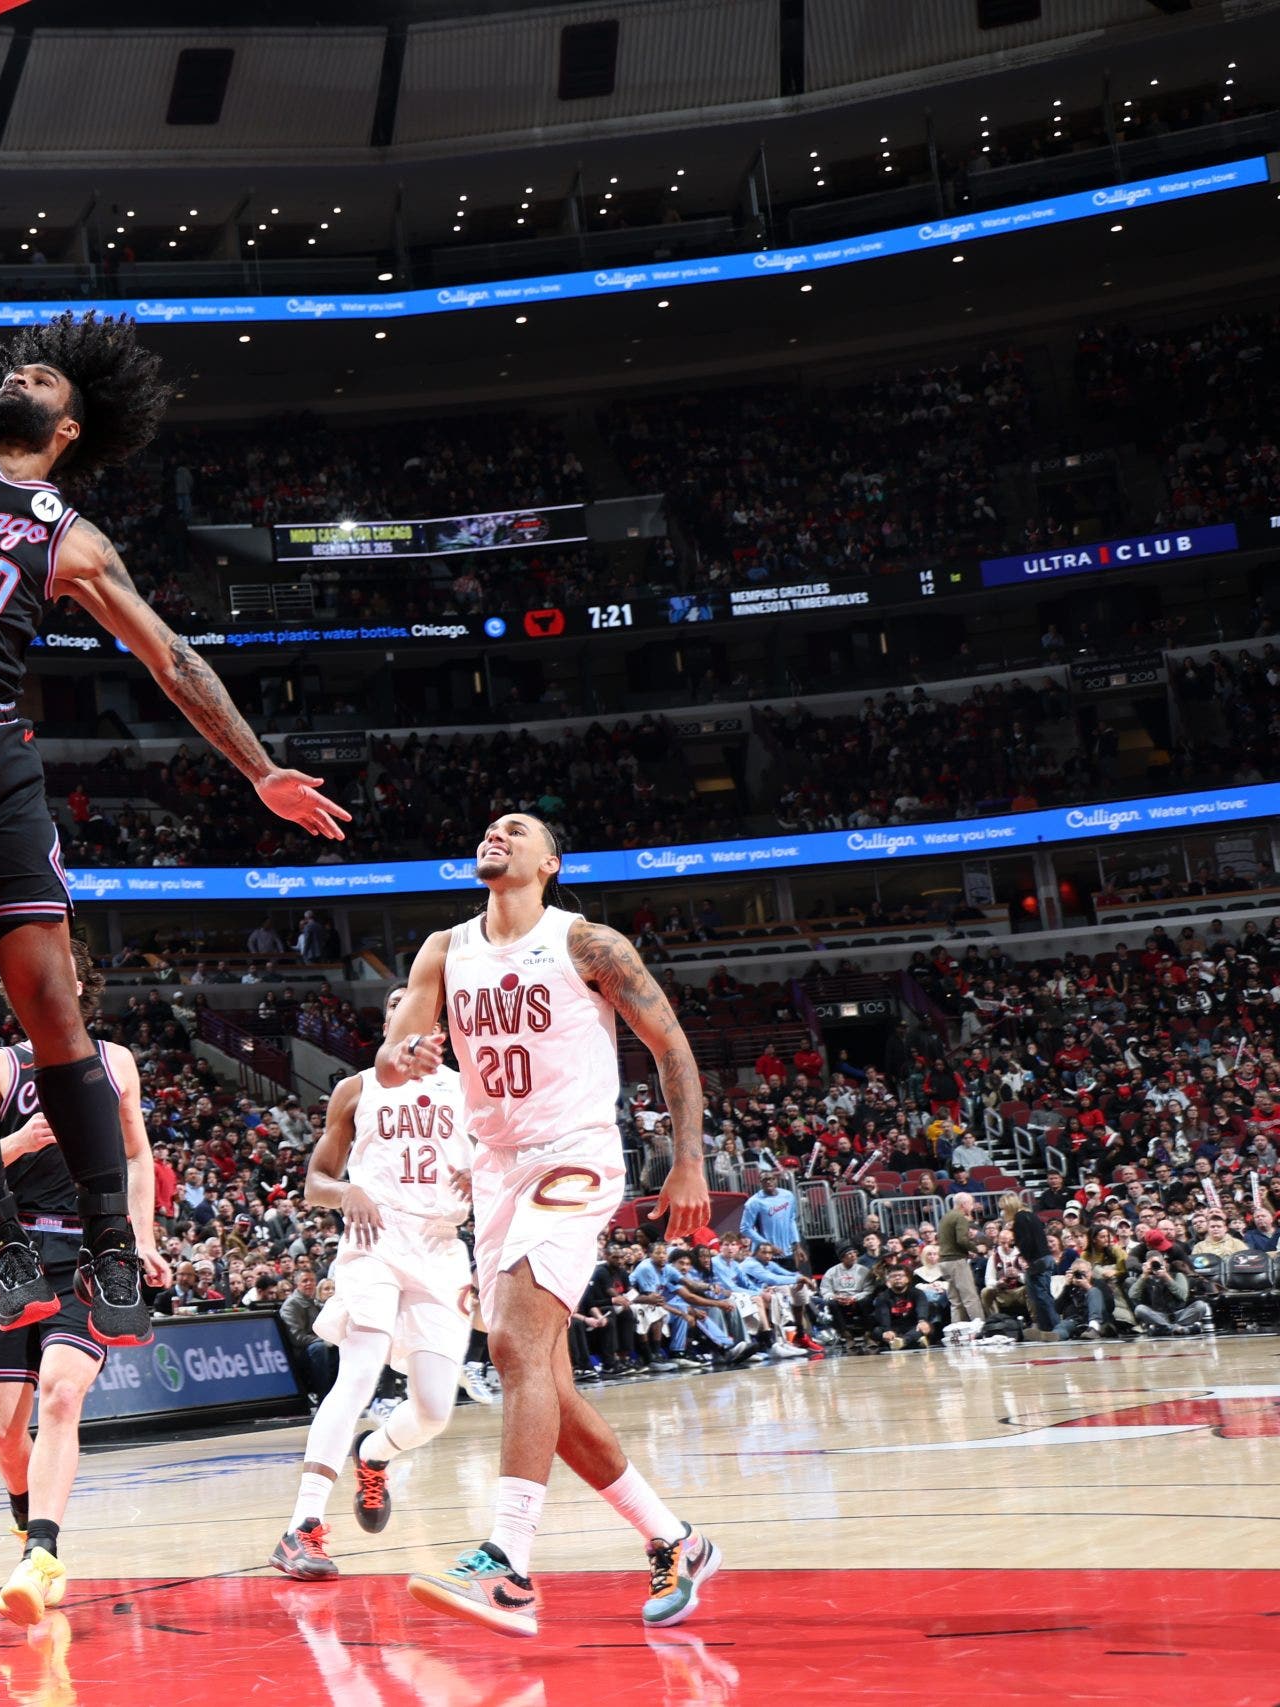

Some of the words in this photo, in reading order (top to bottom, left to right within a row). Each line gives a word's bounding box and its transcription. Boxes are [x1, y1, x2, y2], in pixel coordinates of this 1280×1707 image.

[1093, 188, 1151, 206] Culligan
[919, 223, 974, 240] Culligan
[754, 254, 806, 270] Culligan
[594, 272, 646, 288] Culligan
[287, 299, 335, 317] Culligan
[438, 290, 489, 306] Culligan
[136, 302, 185, 320] Culligan
[1023, 552, 1092, 574] ULTRA
[1115, 535, 1192, 561] CLUB
[730, 586, 778, 603] MEMPHIS
[780, 583, 830, 599] GRIZZLIES
[731, 599, 790, 616] MINNESOTA
[791, 592, 869, 611] TIMBERWOLVES
[588, 604, 633, 629] 7:21
[46, 632, 101, 650] Chicago.
[189, 632, 226, 645] unite
[227, 632, 275, 646] against
[277, 630, 320, 644] plastic
[322, 629, 359, 639] water
[360, 627, 409, 638] bottles.
[411, 624, 469, 638] Chicago.
[1066, 809, 1141, 830] Culligan
[1149, 807, 1187, 818] Water
[1190, 804, 1215, 816] you
[847, 833, 917, 854] Culligan
[924, 834, 960, 843] Water
[962, 832, 985, 843] you
[637, 851, 704, 872] Culligan
[712, 852, 747, 862] Water
[748, 851, 770, 861] you
[128, 879, 159, 889] Water
[160, 881, 180, 890] you
[246, 871, 305, 895] Culligan
[312, 877, 346, 886] Water
[347, 877, 368, 886] you
[523, 957, 554, 965] CLIFFS
[453, 984, 551, 1036] CAVS
[477, 1046, 533, 1098] 20
[377, 1104, 454, 1139] CAVS
[400, 1145, 437, 1184] 12
[184, 1347, 247, 1382] Globe
[249, 1338, 288, 1374] Life
